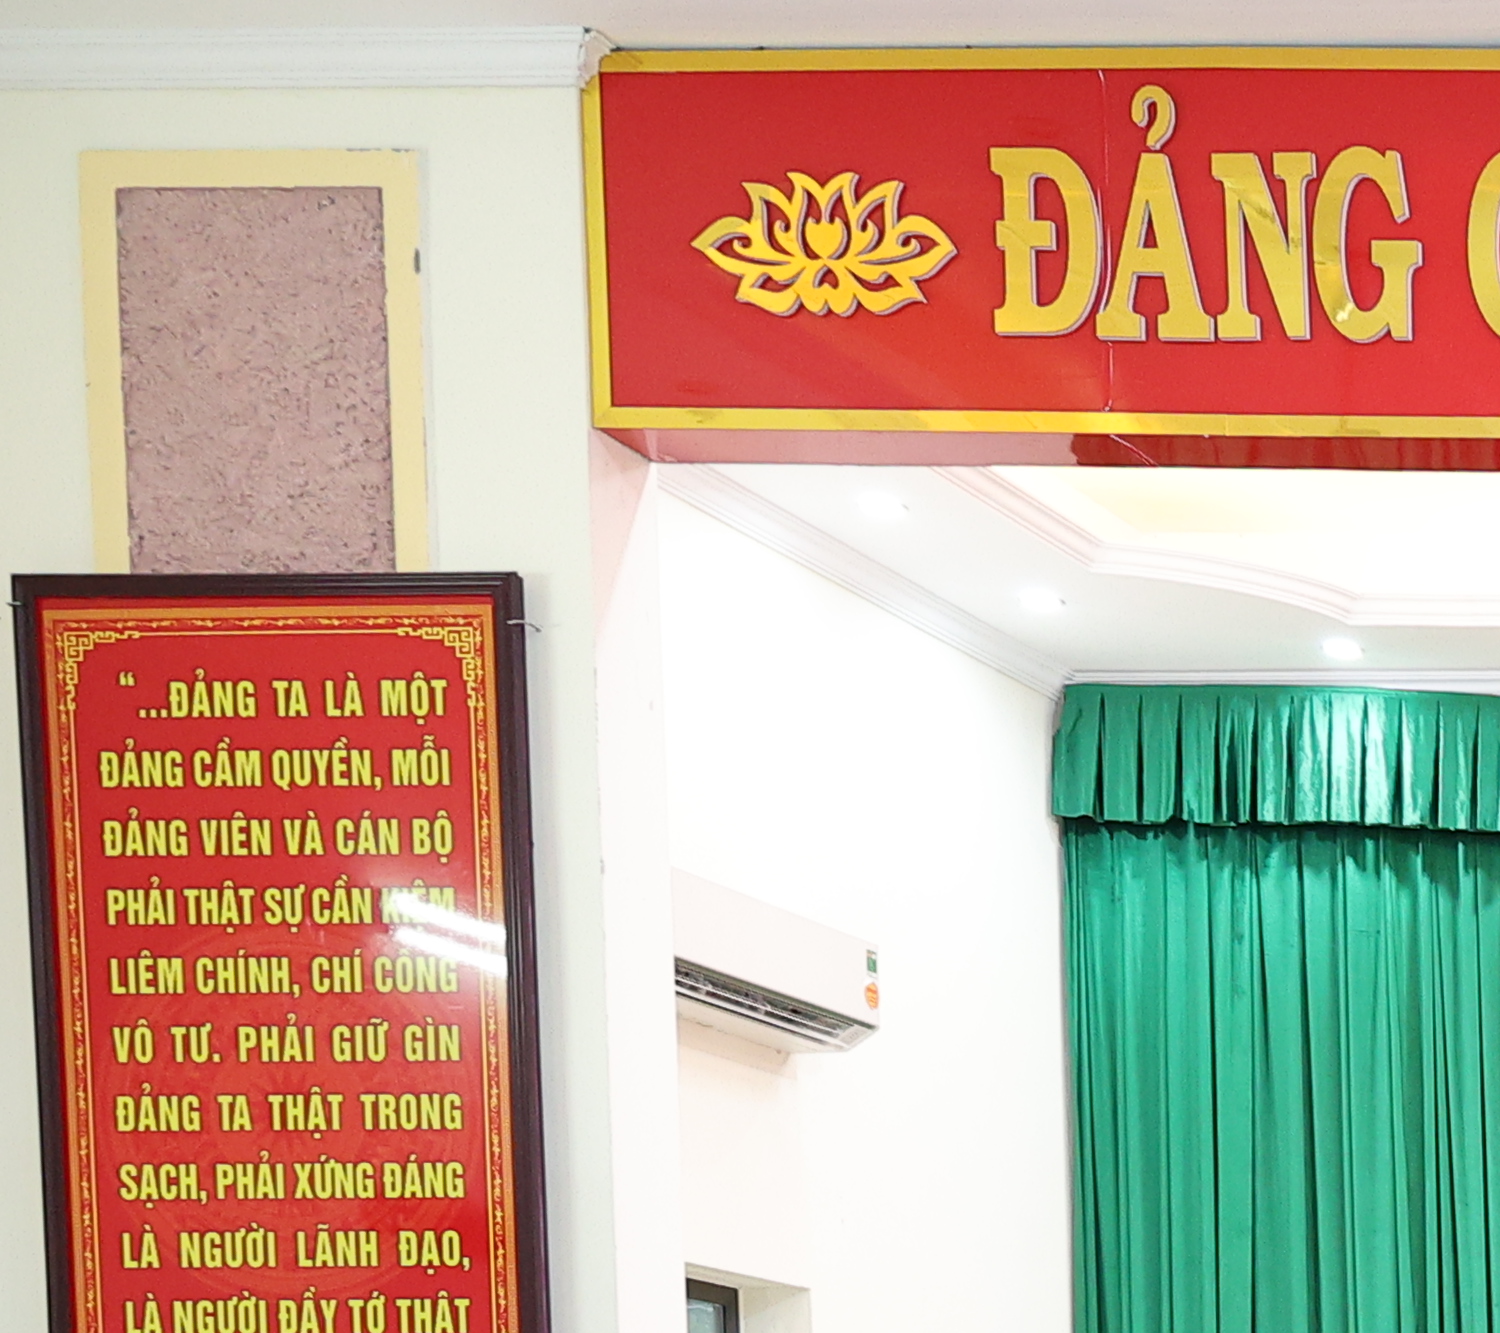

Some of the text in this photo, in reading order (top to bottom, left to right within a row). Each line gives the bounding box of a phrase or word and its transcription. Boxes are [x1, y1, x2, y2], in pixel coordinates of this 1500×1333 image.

[989, 85, 1423, 344] ĐẢNG
[272, 680, 309, 717] TA
[325, 671, 364, 717] LÀ
[380, 671, 448, 725] MỘT
[100, 735, 451, 791] ĐẢNG CẦM QUYỀN, MỖI
[102, 807, 453, 864] ĐẢNG VIÊN VÀ CÁN BỘ
[107, 876, 175, 925] PHẢI
[183, 880, 255, 934] THẬT
[264, 883, 306, 933] SỰ
[311, 874, 373, 925] CẦN
[110, 948, 459, 998] LIÊM CHÍNH, CHÍ CÔNG
[112, 1010, 461, 1064] VÔ TƯ. PHẢI GIỮ GÌN
[116, 1082, 463, 1139] ĐẢNG TA THẬT TRONG
[119, 1150, 465, 1209] SẠCH, PHẢI XỨNG ĐÁNG
[122, 1222, 470, 1275] LÀ NGƯỜI LÃNH ĐẠO,
